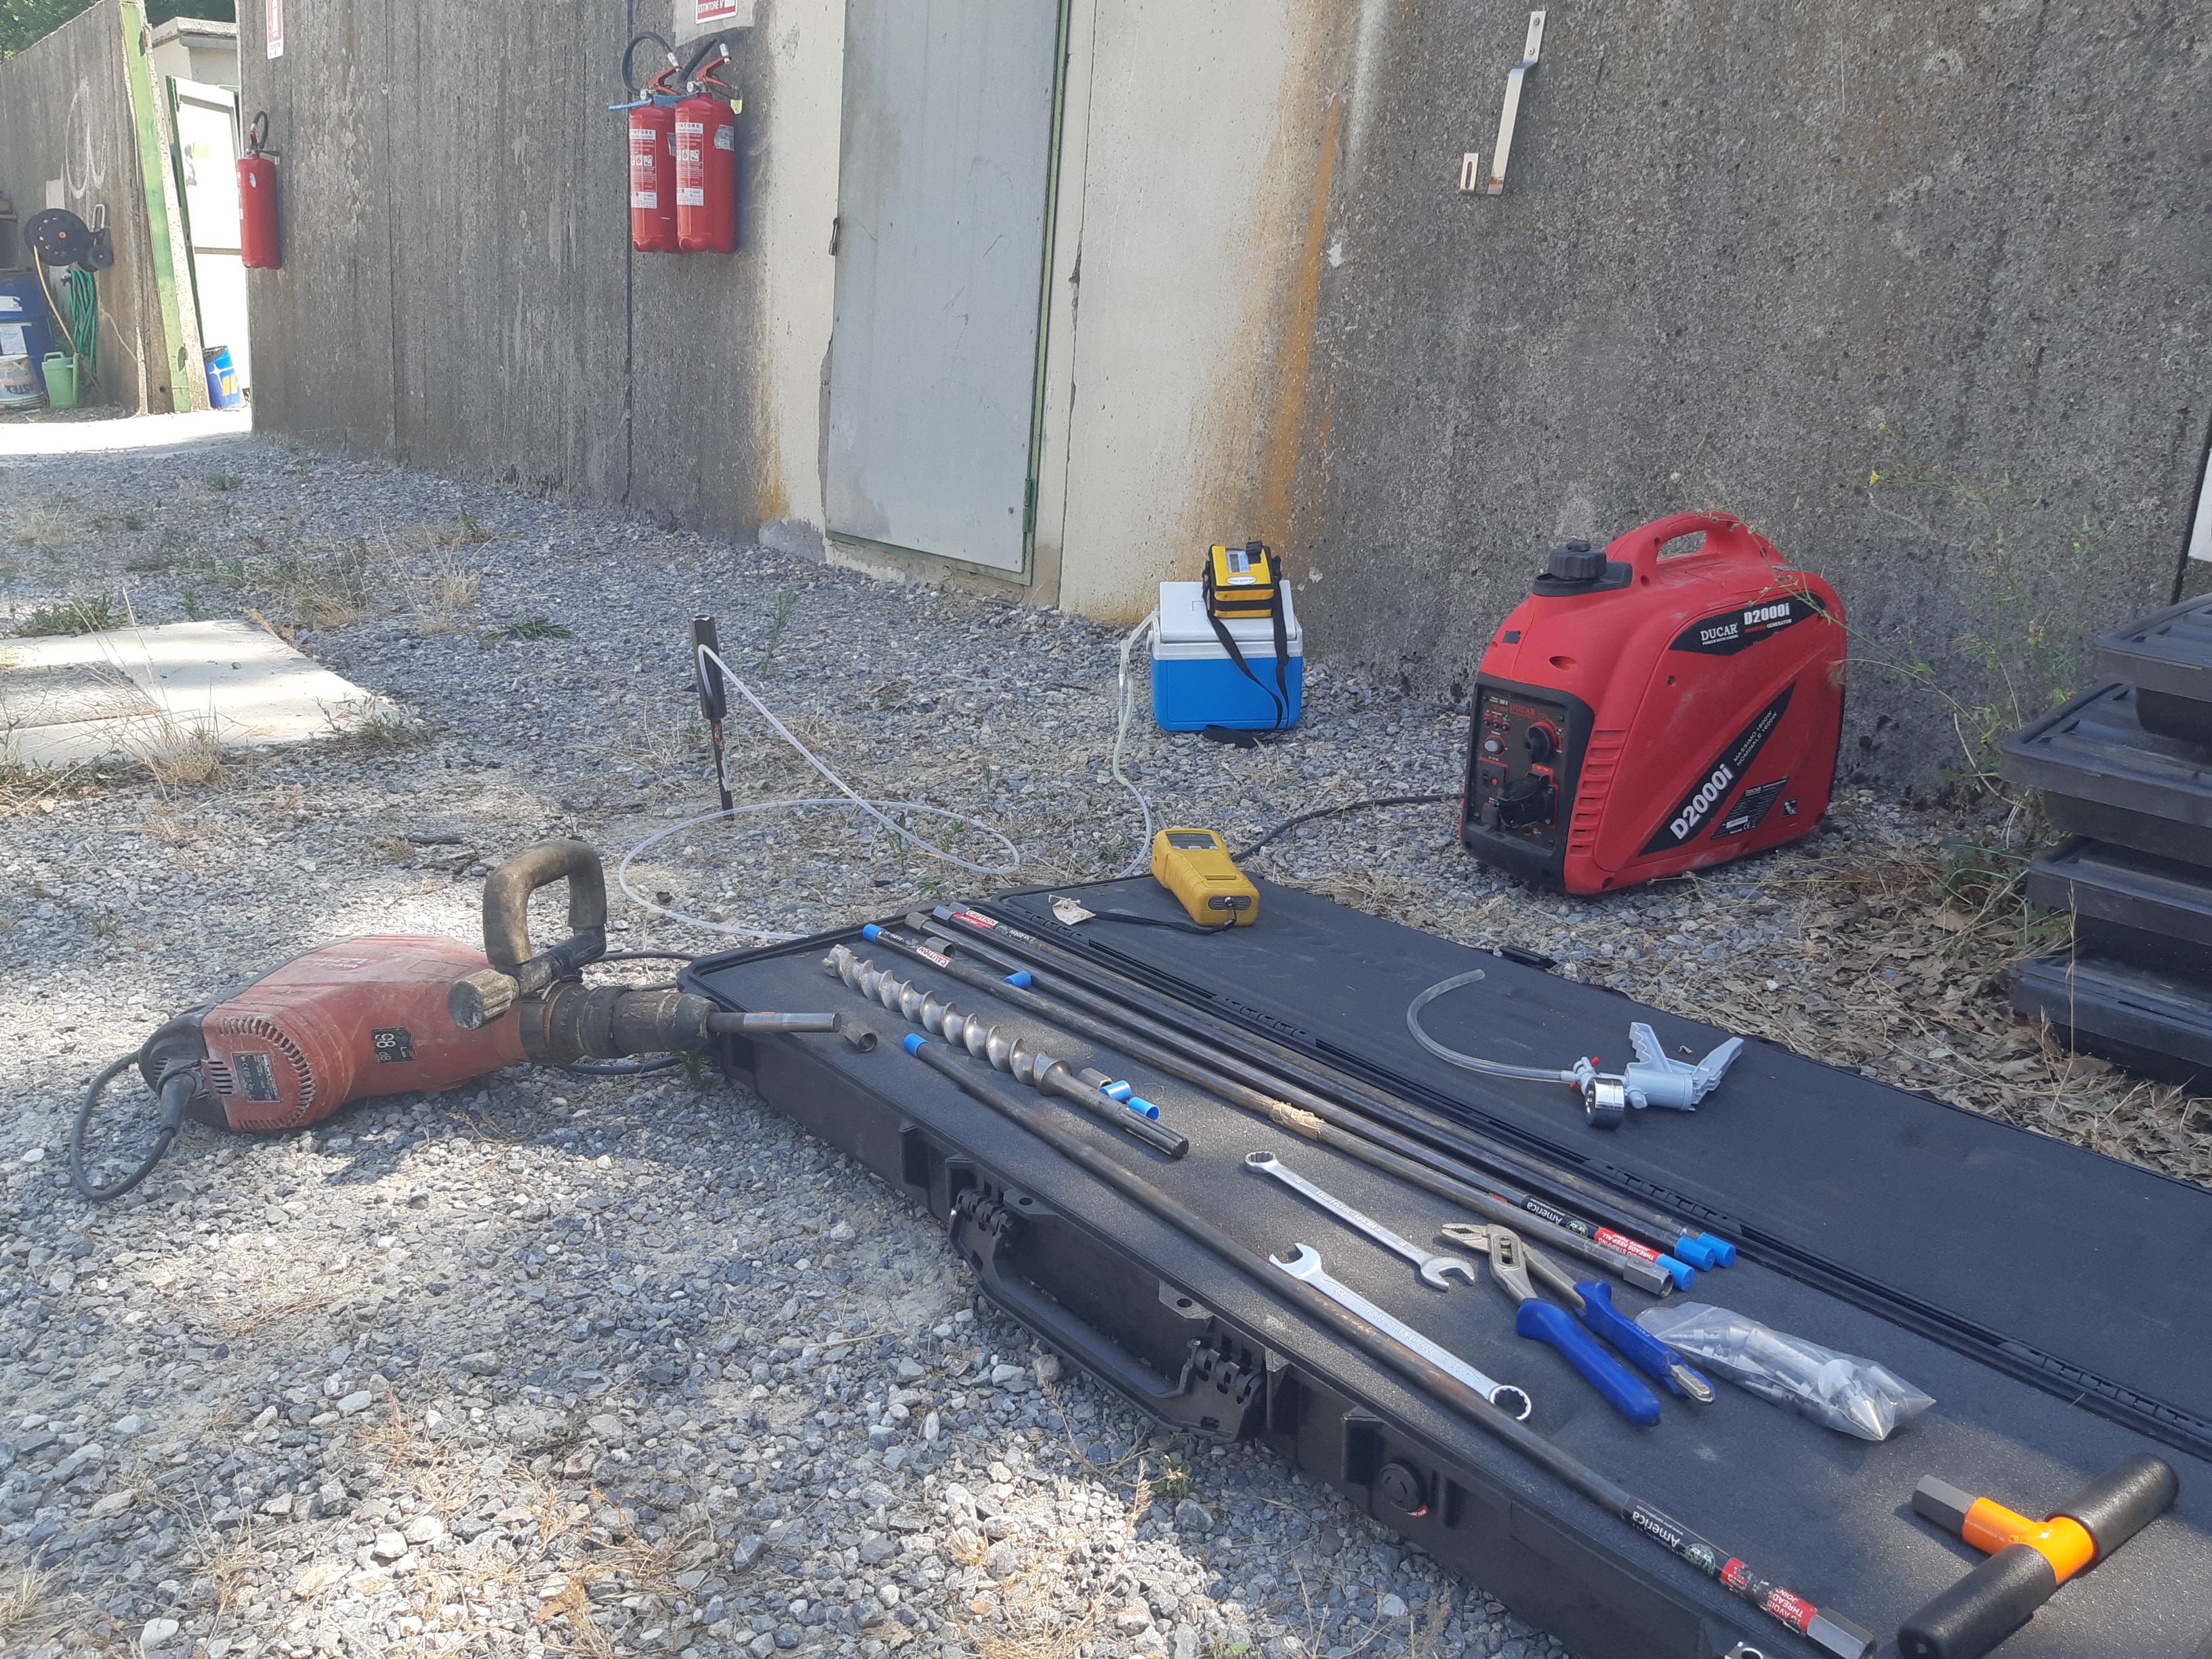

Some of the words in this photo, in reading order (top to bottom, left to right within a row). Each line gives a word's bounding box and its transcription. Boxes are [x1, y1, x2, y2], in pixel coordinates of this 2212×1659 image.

[698, 1, 718, 14] ESTINTORE
[1744, 602, 1790, 626] D2000i
[1700, 623, 1738, 641] DUCAR
[1767, 619, 1792, 629] GENERATOR
[1510, 703, 1536, 716] DUCAR
[1733, 731, 1757, 763] MASSIMO
[1736, 733, 1762, 766] NOMINALE
[1761, 712, 1778, 733] 1600W
[1669, 763, 1735, 840] D2000i
[967, 910, 997, 926] CAUTION
[918, 947, 947, 966] CAUTION
[379, 1052, 392, 1061] dB
[1526, 1202, 1563, 1225] America
[1602, 1232, 1613, 1240] ALL
[1612, 1233, 1631, 1243] TIGHT
[1612, 1239, 1629, 1248] KEEP
[1598, 1237, 1627, 1254] STRIPPING
[1627, 1245, 1655, 1261] THREADS
[1630, 1241, 1651, 1252] JOINTS
[1358, 1303, 1394, 1327] CHROME
[1632, 1511, 1681, 1548] America
[1776, 1587, 1799, 1603] JOIN
[1766, 1600, 1790, 1618] AVOID
[1768, 1590, 1804, 1618] THREADS
